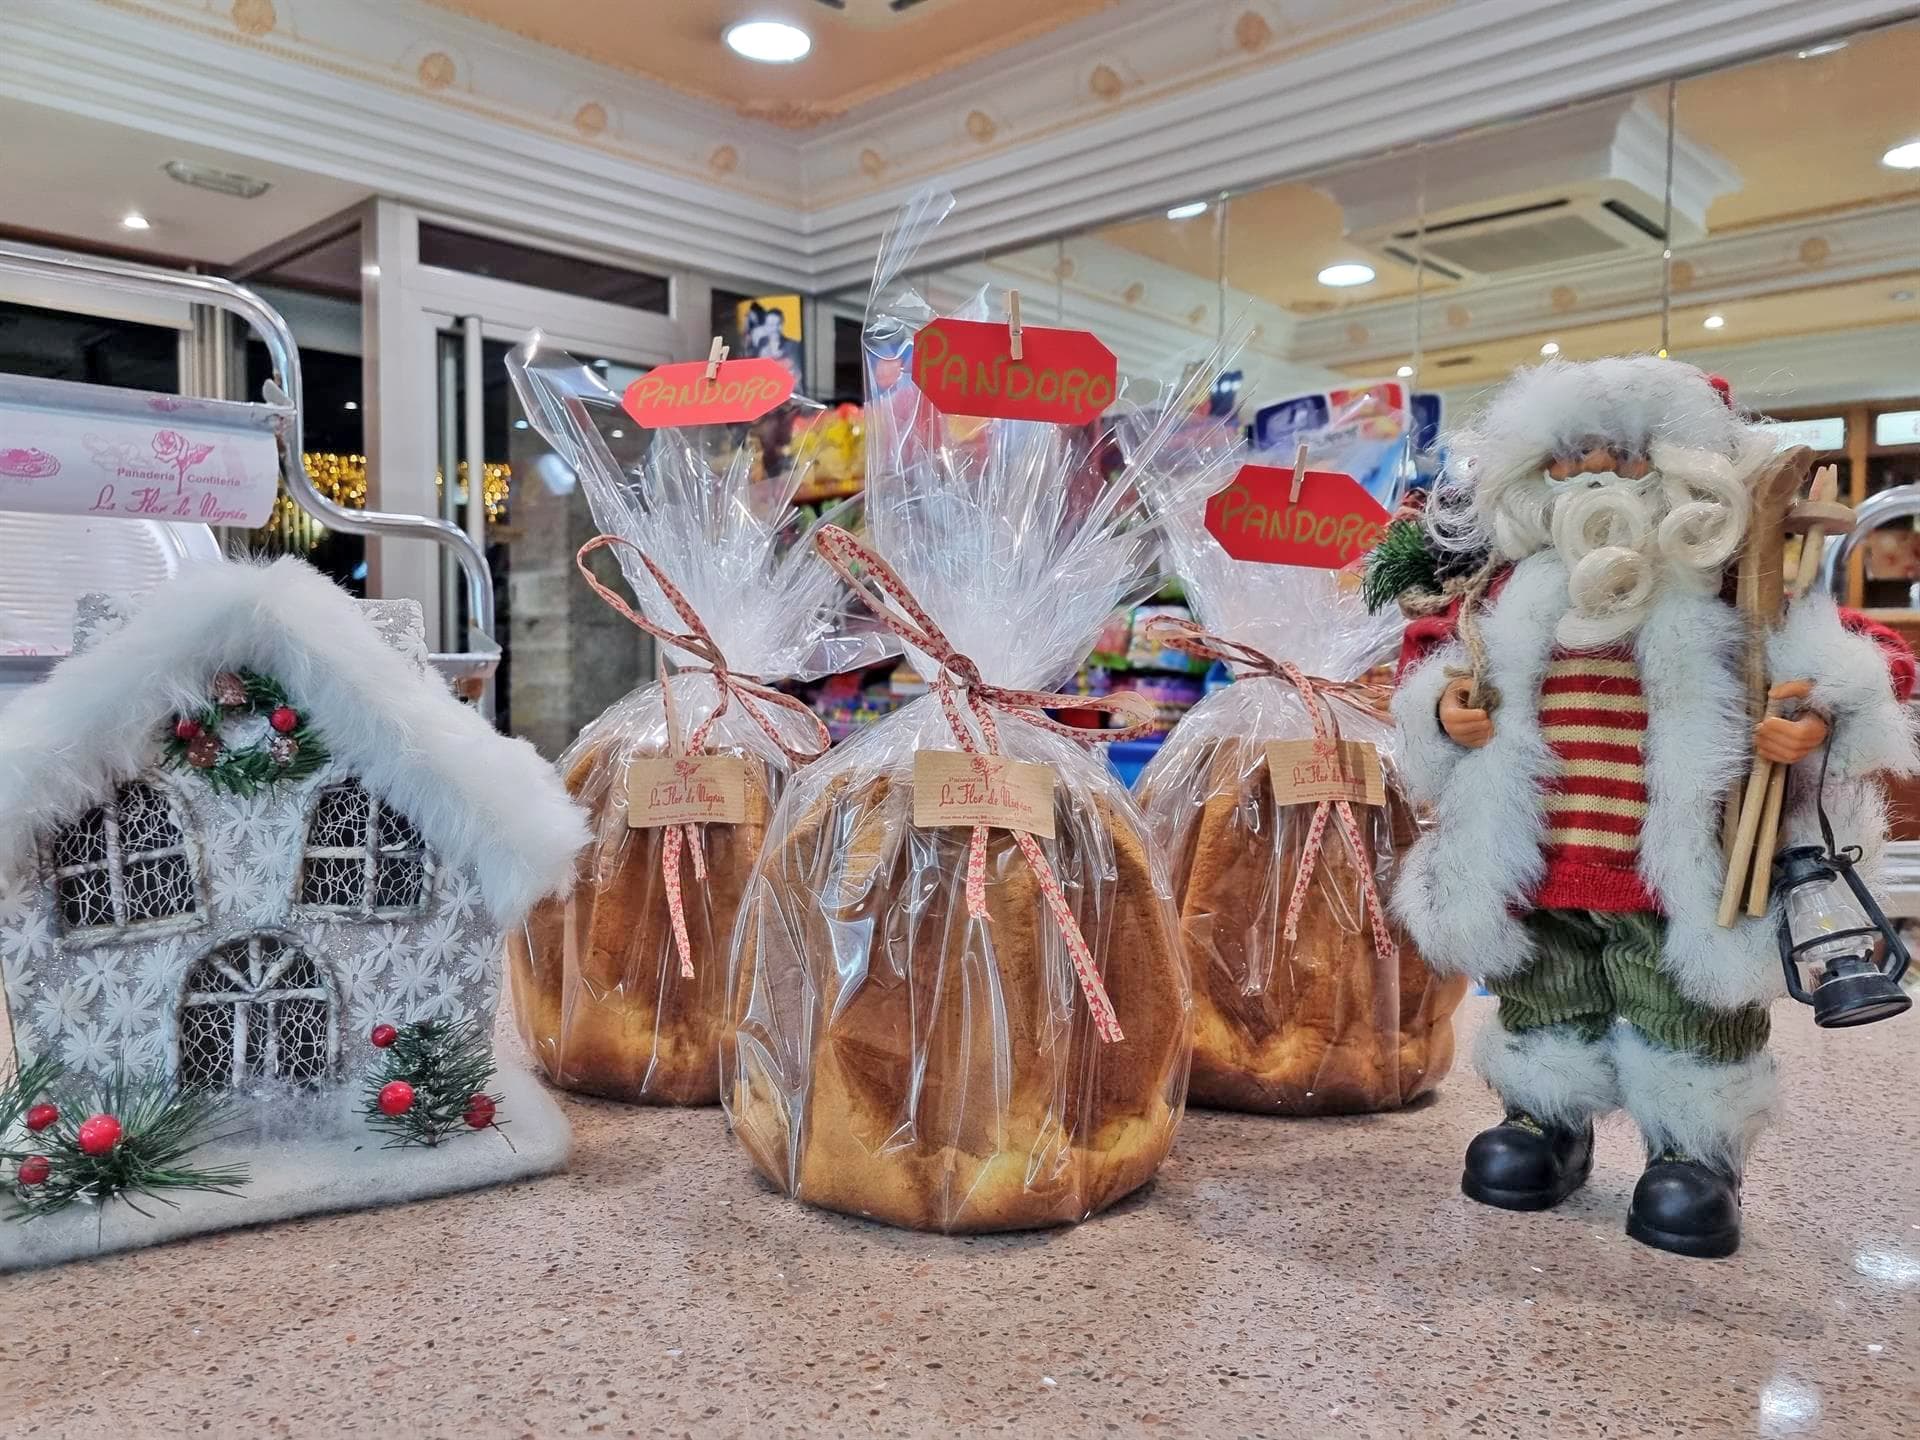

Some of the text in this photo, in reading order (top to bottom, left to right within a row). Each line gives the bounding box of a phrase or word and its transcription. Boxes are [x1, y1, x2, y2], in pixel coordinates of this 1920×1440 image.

[917, 327, 1112, 414] PANDORO
[632, 375, 782, 413] PANDORO
[89, 484, 116, 512] La
[125, 487, 168, 514] Flor
[172, 496, 191, 516] de
[1214, 484, 1387, 560] PANDORO
[939, 783, 953, 807] La
[957, 783, 984, 805] Flor
[987, 788, 998, 805] de
